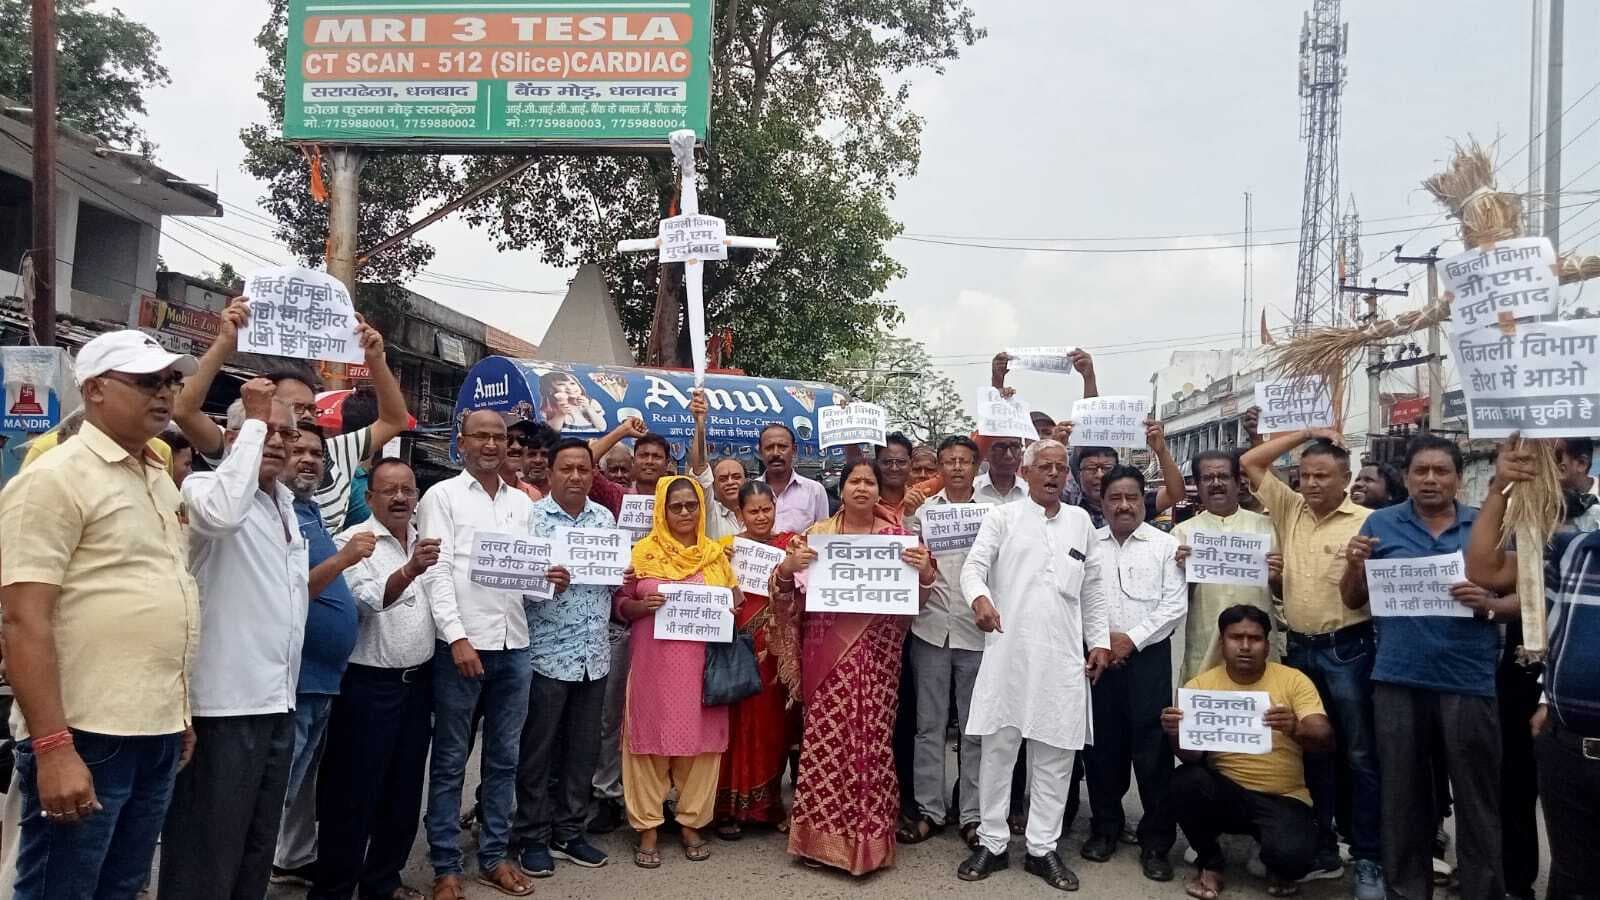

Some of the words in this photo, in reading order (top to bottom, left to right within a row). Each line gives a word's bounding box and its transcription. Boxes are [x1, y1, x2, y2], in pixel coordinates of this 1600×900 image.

[314, 17, 426, 42] MRI
[451, 17, 486, 41] 3
[512, 16, 680, 41] TESLA
[305, 53, 338, 74] CT
[345, 52, 414, 74] SCAN
[438, 52, 482, 73] 512
[406, 85, 470, 97] धनबाद
[514, 83, 552, 97] बैंक
[609, 86, 679, 97] धनबाद
[405, 118, 476, 128] 7759880002
[611, 118, 686, 128] 7759880004
[1445, 251, 1490, 281] बिजली
[1494, 245, 1541, 266] विभाग
[1455, 265, 1543, 299] जी.एम.
[1458, 286, 1551, 325] मुर्दाबाद
[167, 307, 199, 328] Mobile
[1458, 334, 1514, 364] बिजली
[1520, 332, 1598, 359] विभाग
[1470, 367, 1497, 392] होश
[1500, 364, 1518, 390] में
[1523, 361, 1587, 388] आओ
[473, 373, 510, 400] Amul
[644, 375, 785, 415] Amul
[652, 413, 677, 424] Real
[711, 415, 734, 426] Real
[1529, 399, 1574, 426] चुकी
[1578, 398, 1594, 420] है
[3, 418, 51, 429] MANDIR
[926, 508, 959, 522] बिजली
[930, 523, 950, 536] होश
[480, 540, 511, 553] लचर
[512, 540, 552, 557] बिजली
[566, 532, 621, 547] बिजली
[1193, 532, 1228, 547] बिजली
[1230, 535, 1262, 550] विभाग
[568, 547, 619, 562] विभाग
[735, 545, 757, 557] स्मार्ट
[755, 546, 782, 563] बिजली
[824, 541, 904, 561] बिजली
[1191, 546, 1258, 565] जी.एम.
[477, 554, 496, 568] को
[498, 555, 527, 570] ठीक
[1191, 562, 1262, 579] मुर्दाबाद
[1370, 565, 1397, 579] स्मार्ट
[1399, 563, 1438, 579] बिजली
[1439, 559, 1460, 576] नहीं
[828, 563, 902, 582] विभाग
[818, 584, 912, 607] मुर्दाबाद
[1382, 582, 1396, 594] तो
[1398, 581, 1425, 594] स्मार्ट
[1427, 581, 1453, 593] मीट
[683, 590, 713, 605] बिजली
[1384, 597, 1397, 611] भी
[1399, 596, 1421, 610] नहीं
[1422, 595, 1457, 610] लगेगा
[667, 605, 678, 617] तो
[679, 606, 701, 619] स्मार्ट
[665, 621, 676, 632] भी
[677, 622, 694, 635] नहीं
[695, 623, 721, 636] लगेगा
[1190, 694, 1258, 712] बिजली
[1193, 711, 1255, 728] विभाग
[1186, 728, 1264, 746] मुर्दाबाद
